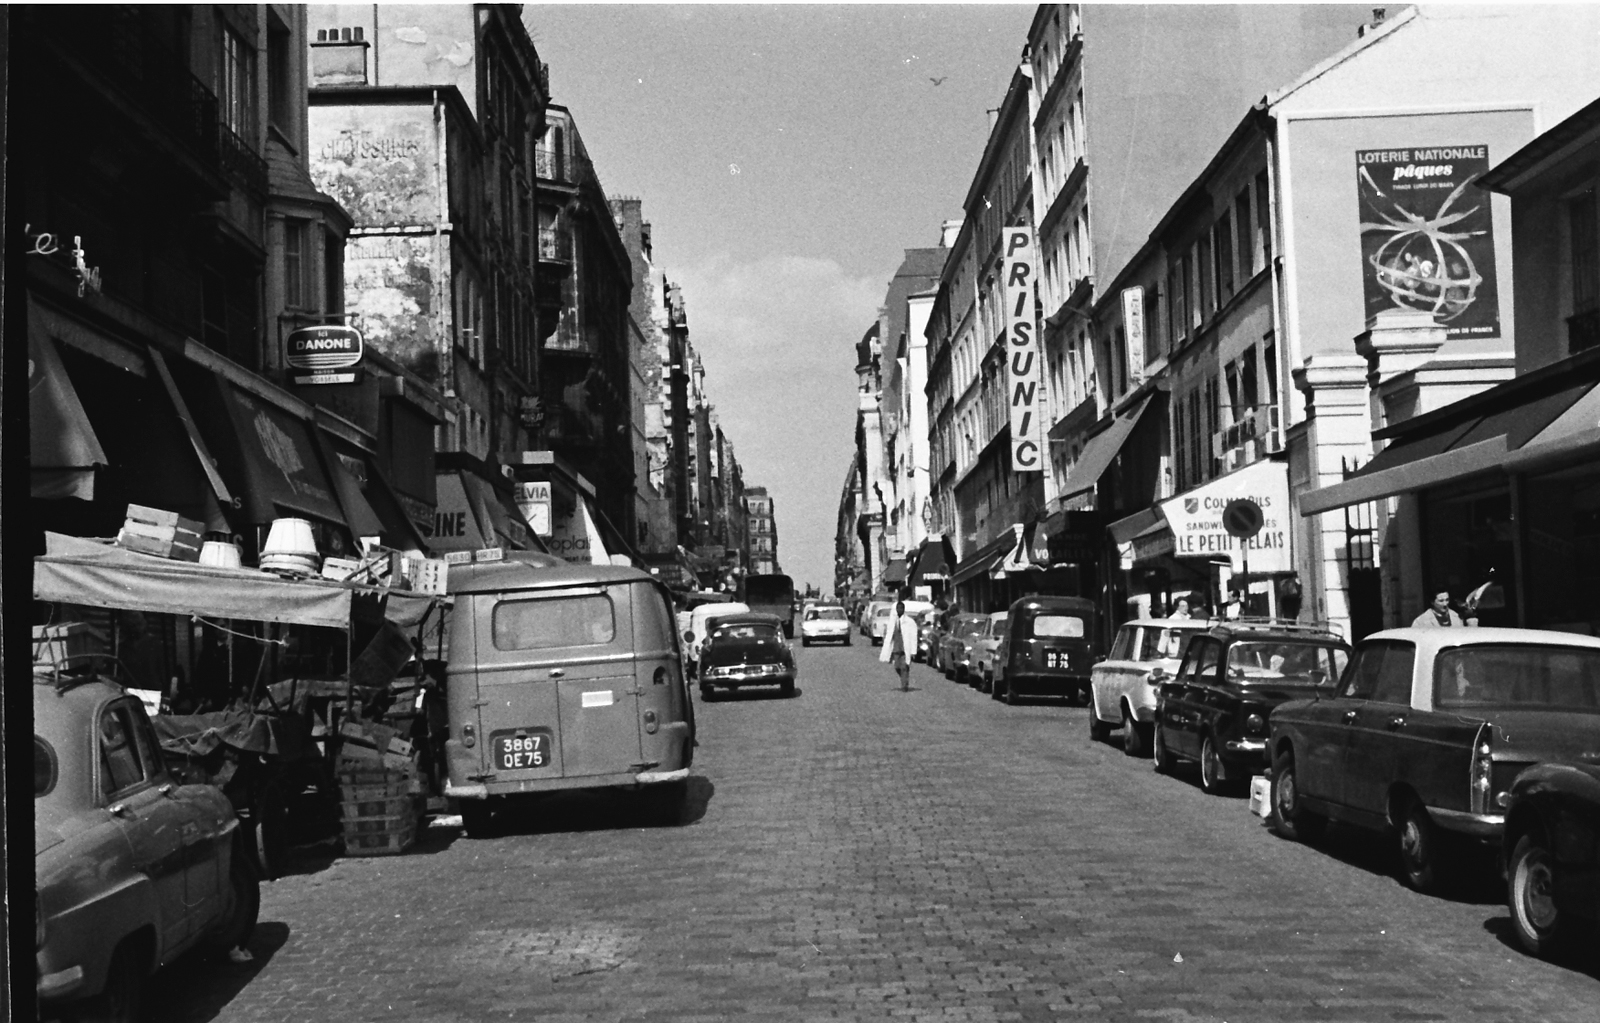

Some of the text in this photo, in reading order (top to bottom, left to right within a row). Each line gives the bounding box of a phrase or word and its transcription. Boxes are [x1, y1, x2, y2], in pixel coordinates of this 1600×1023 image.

[1358, 148, 1485, 163] LOTERIE NATIONALE
[1393, 164, 1453, 180] pâques
[296, 338, 351, 351] DANONE
[1006, 232, 1037, 467] PRISUNIC
[1179, 535, 1194, 552] LE
[1199, 534, 1232, 551] PETIT
[504, 737, 541, 753] 3867
[525, 751, 542, 766] 75
